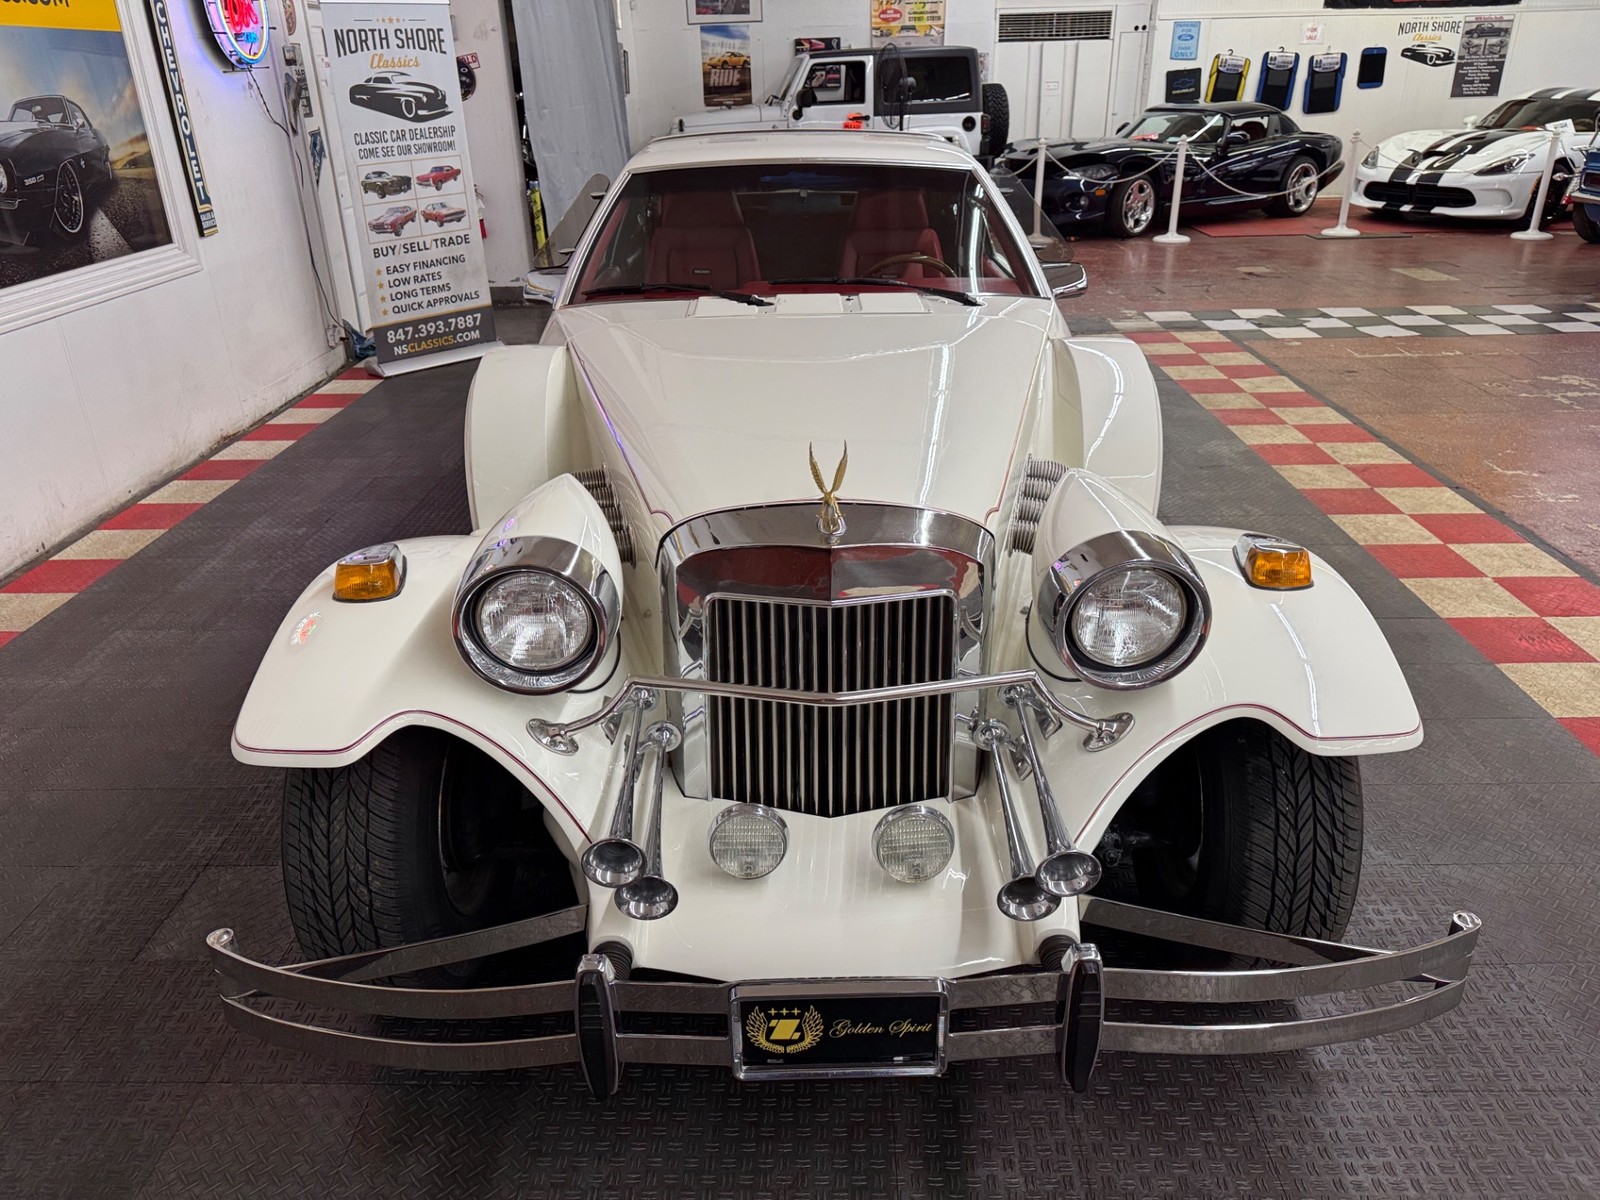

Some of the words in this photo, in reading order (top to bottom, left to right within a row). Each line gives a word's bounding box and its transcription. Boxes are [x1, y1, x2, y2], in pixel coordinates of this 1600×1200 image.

[1398, 21, 1429, 36] NORTH
[1431, 20, 1462, 34] SHORE
[1412, 33, 1442, 41] Classics
[333, 28, 391, 58] NORTH
[394, 28, 447, 55] SHORE
[369, 52, 421, 70] Classics
[709, 68, 741, 87] RIDE
[155, 2, 206, 200] CHEVROLET
[353, 130, 389, 146] CLASSIC
[390, 129, 407, 142] CAR
[409, 125, 456, 141] DEALERSHIP
[358, 146, 380, 160] COME
[381, 145, 395, 157] SEE
[397, 143, 413, 156] OUR
[414, 140, 456, 154] SHOWROOM!
[372, 233, 471, 259] BUY/SELL/TRADE
[386, 262, 411, 275] EASY
[413, 254, 466, 271] FINANCING
[387, 276, 411, 289] LOW
[413, 271, 442, 284] RATES
[390, 289, 418, 302] LONG
[420, 283, 451, 296] TERMS
[392, 301, 425, 315] QUICK
[426, 290, 480, 309] APPROVALS
[386, 313, 482, 344] 847.393.7887
[393, 329, 481, 356] NSCLASSICS.COM
[829, 1018, 885, 1038] Golden
[888, 1018, 933, 1038] Spirit
